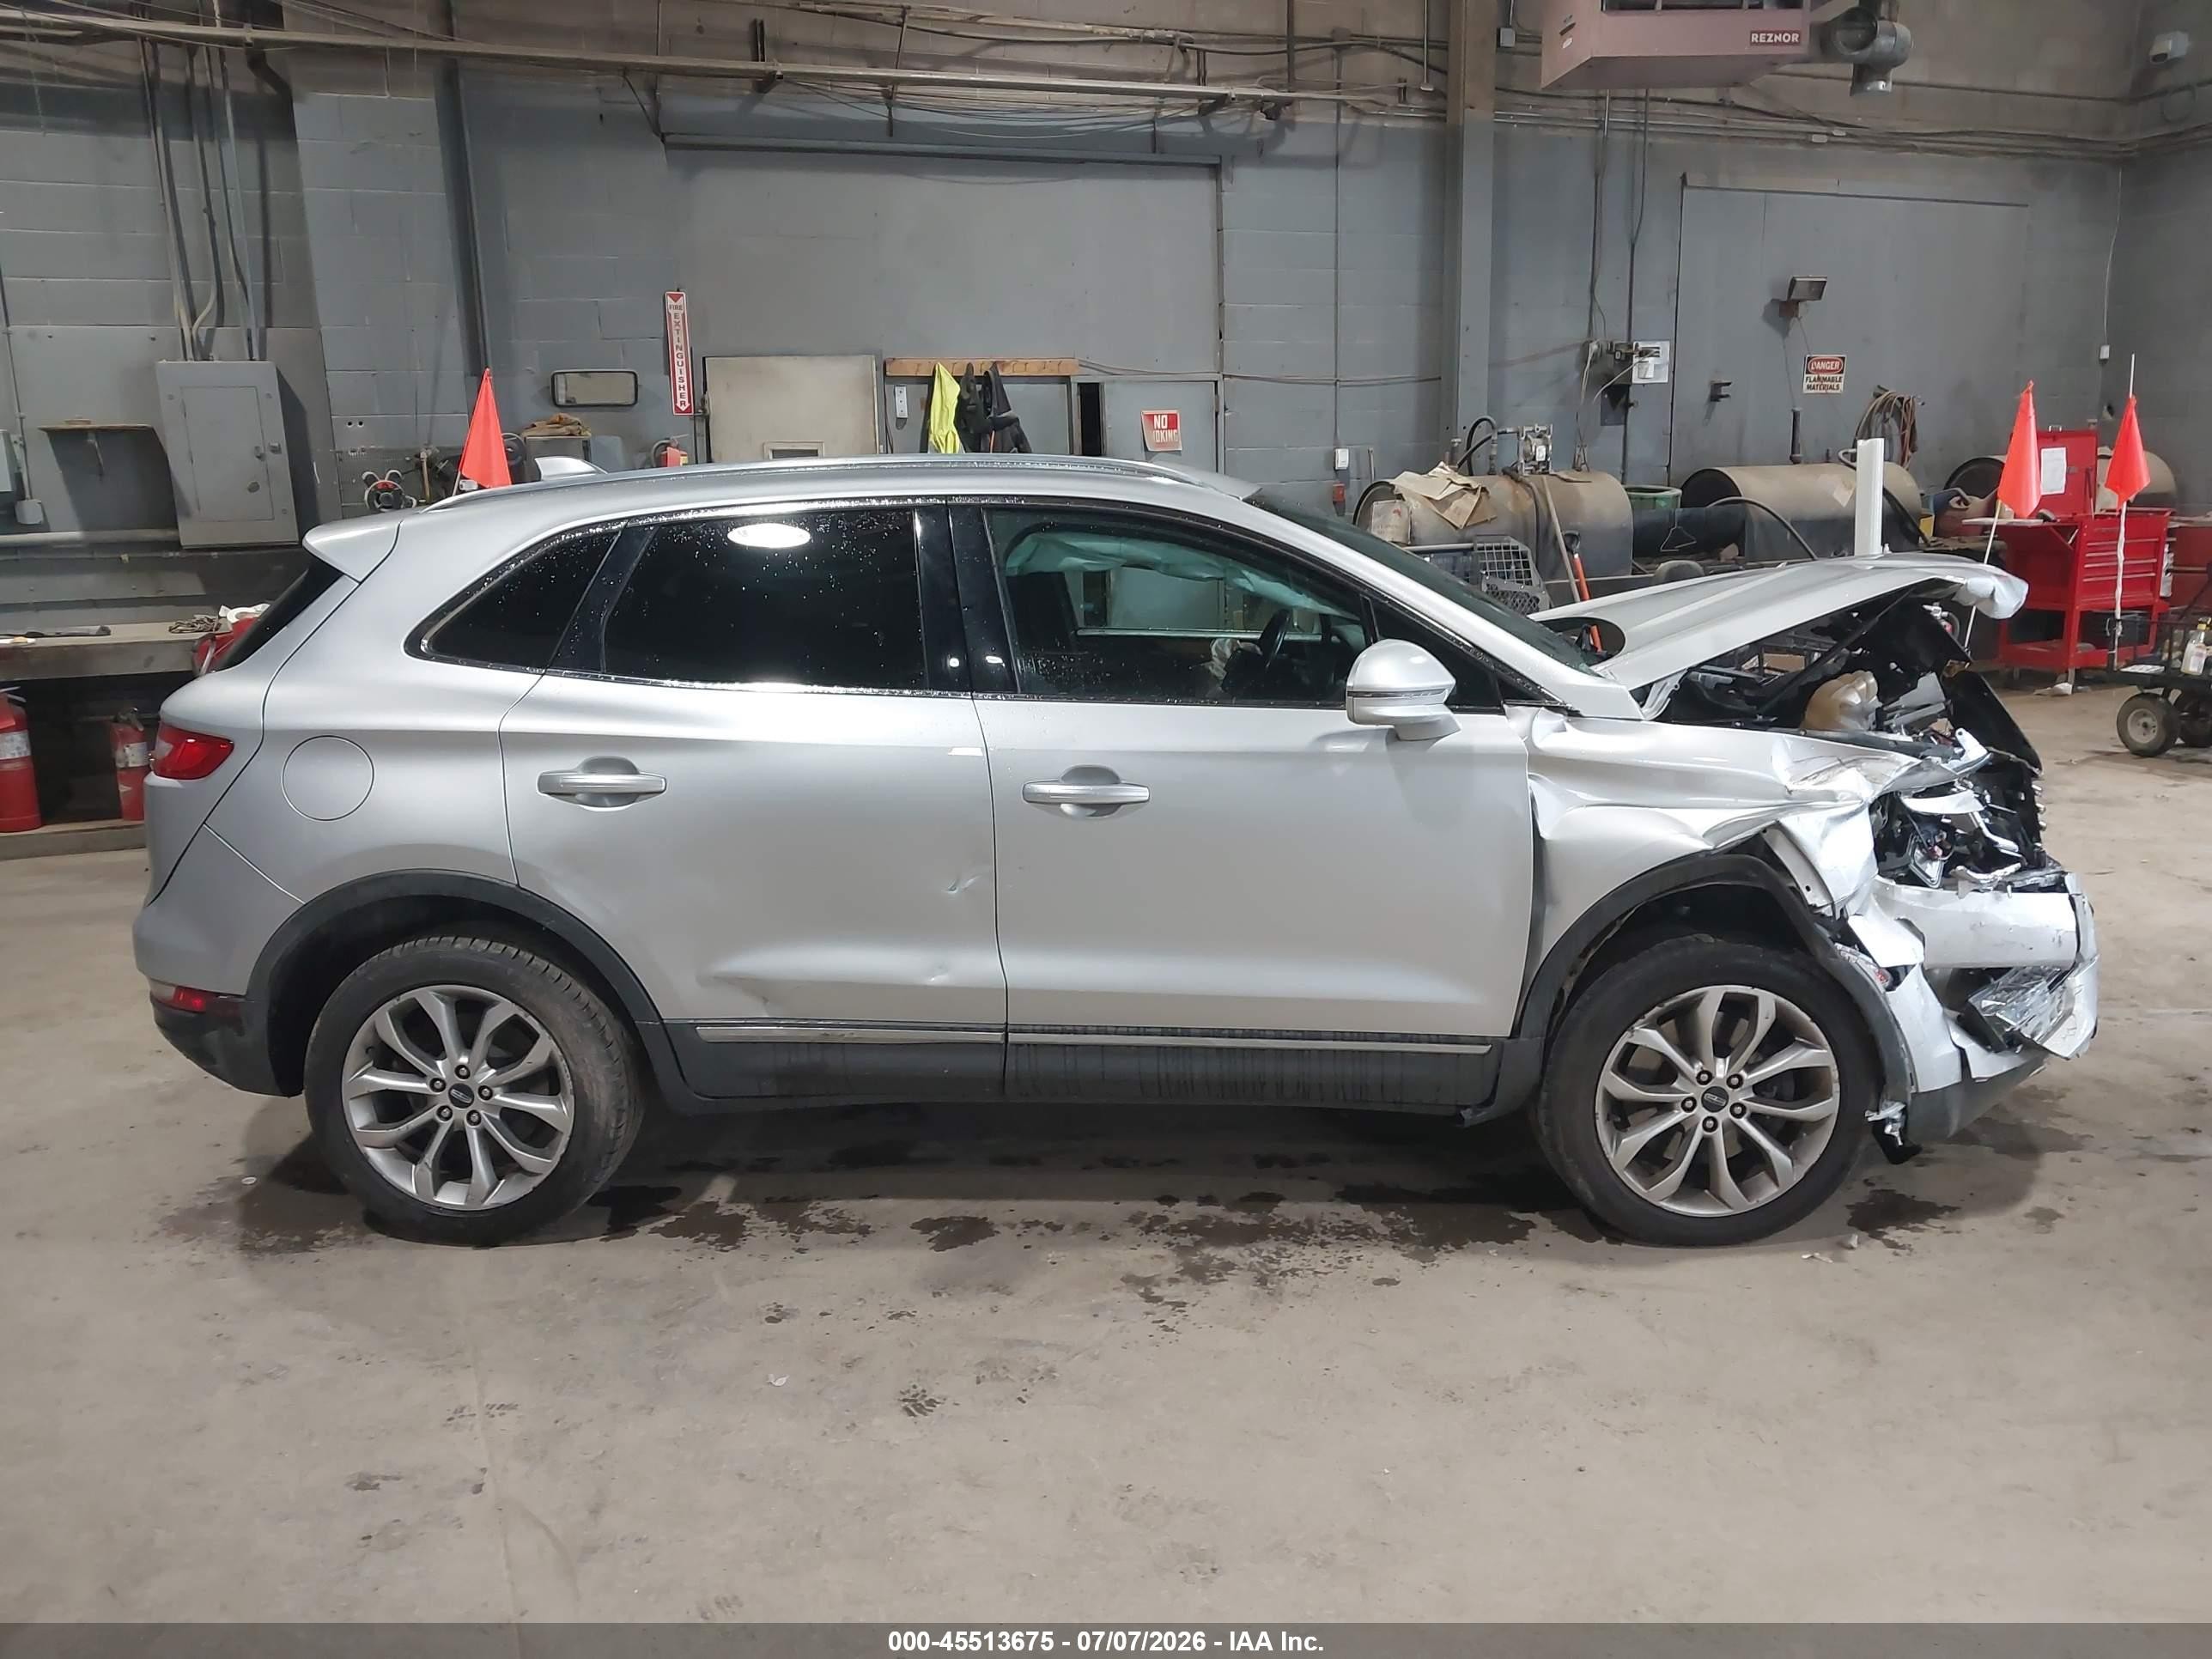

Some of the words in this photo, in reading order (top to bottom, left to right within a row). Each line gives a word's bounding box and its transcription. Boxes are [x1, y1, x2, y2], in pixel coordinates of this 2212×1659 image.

[1751, 33, 1800, 43] REZNOR
[673, 313, 686, 407] EXTINGUISHER
[1811, 361, 1840, 370] DANGER
[1153, 414, 1168, 429] NO
